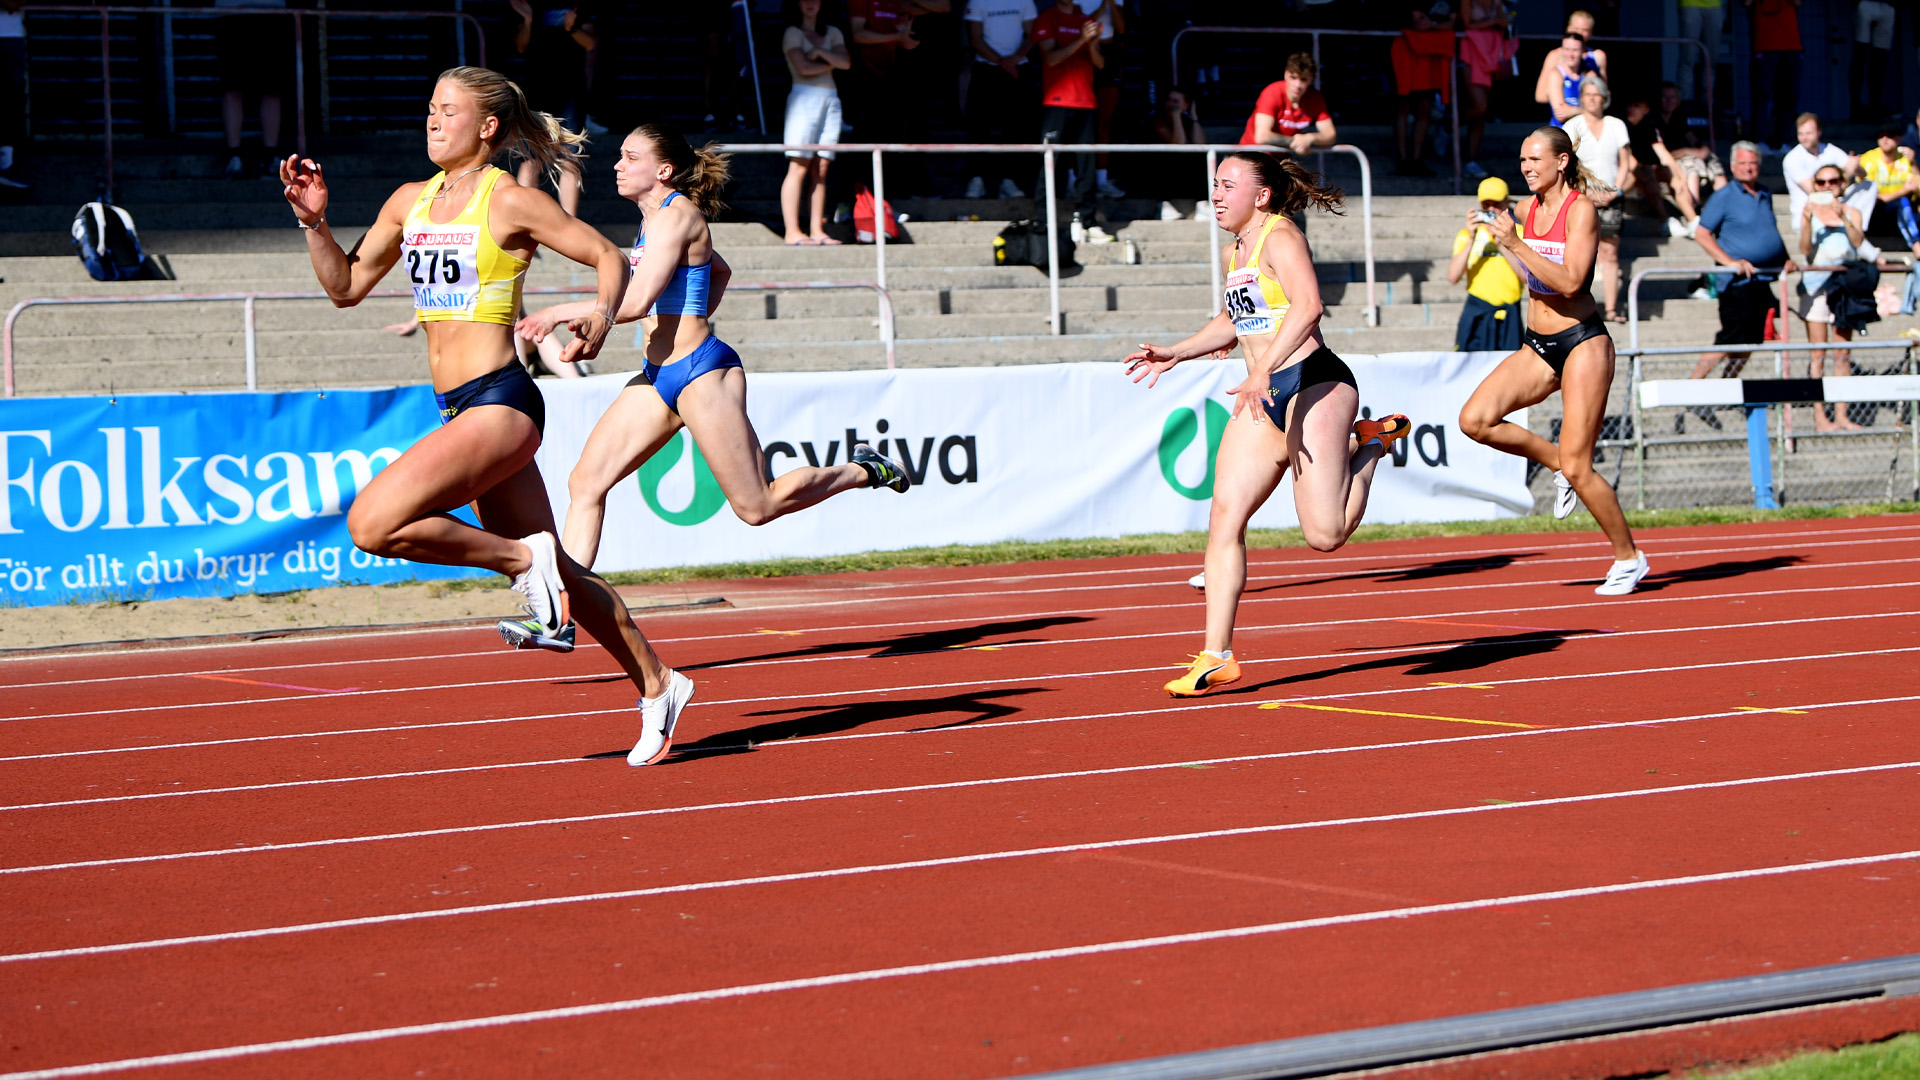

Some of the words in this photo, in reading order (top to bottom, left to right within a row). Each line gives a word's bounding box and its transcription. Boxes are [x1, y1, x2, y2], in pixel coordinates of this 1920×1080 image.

[408, 249, 461, 284] 275
[1225, 287, 1256, 320] 335
[61, 553, 127, 589] allt
[136, 551, 185, 585] du
[195, 548, 275, 587] bryr
[283, 540, 342, 580] dig
